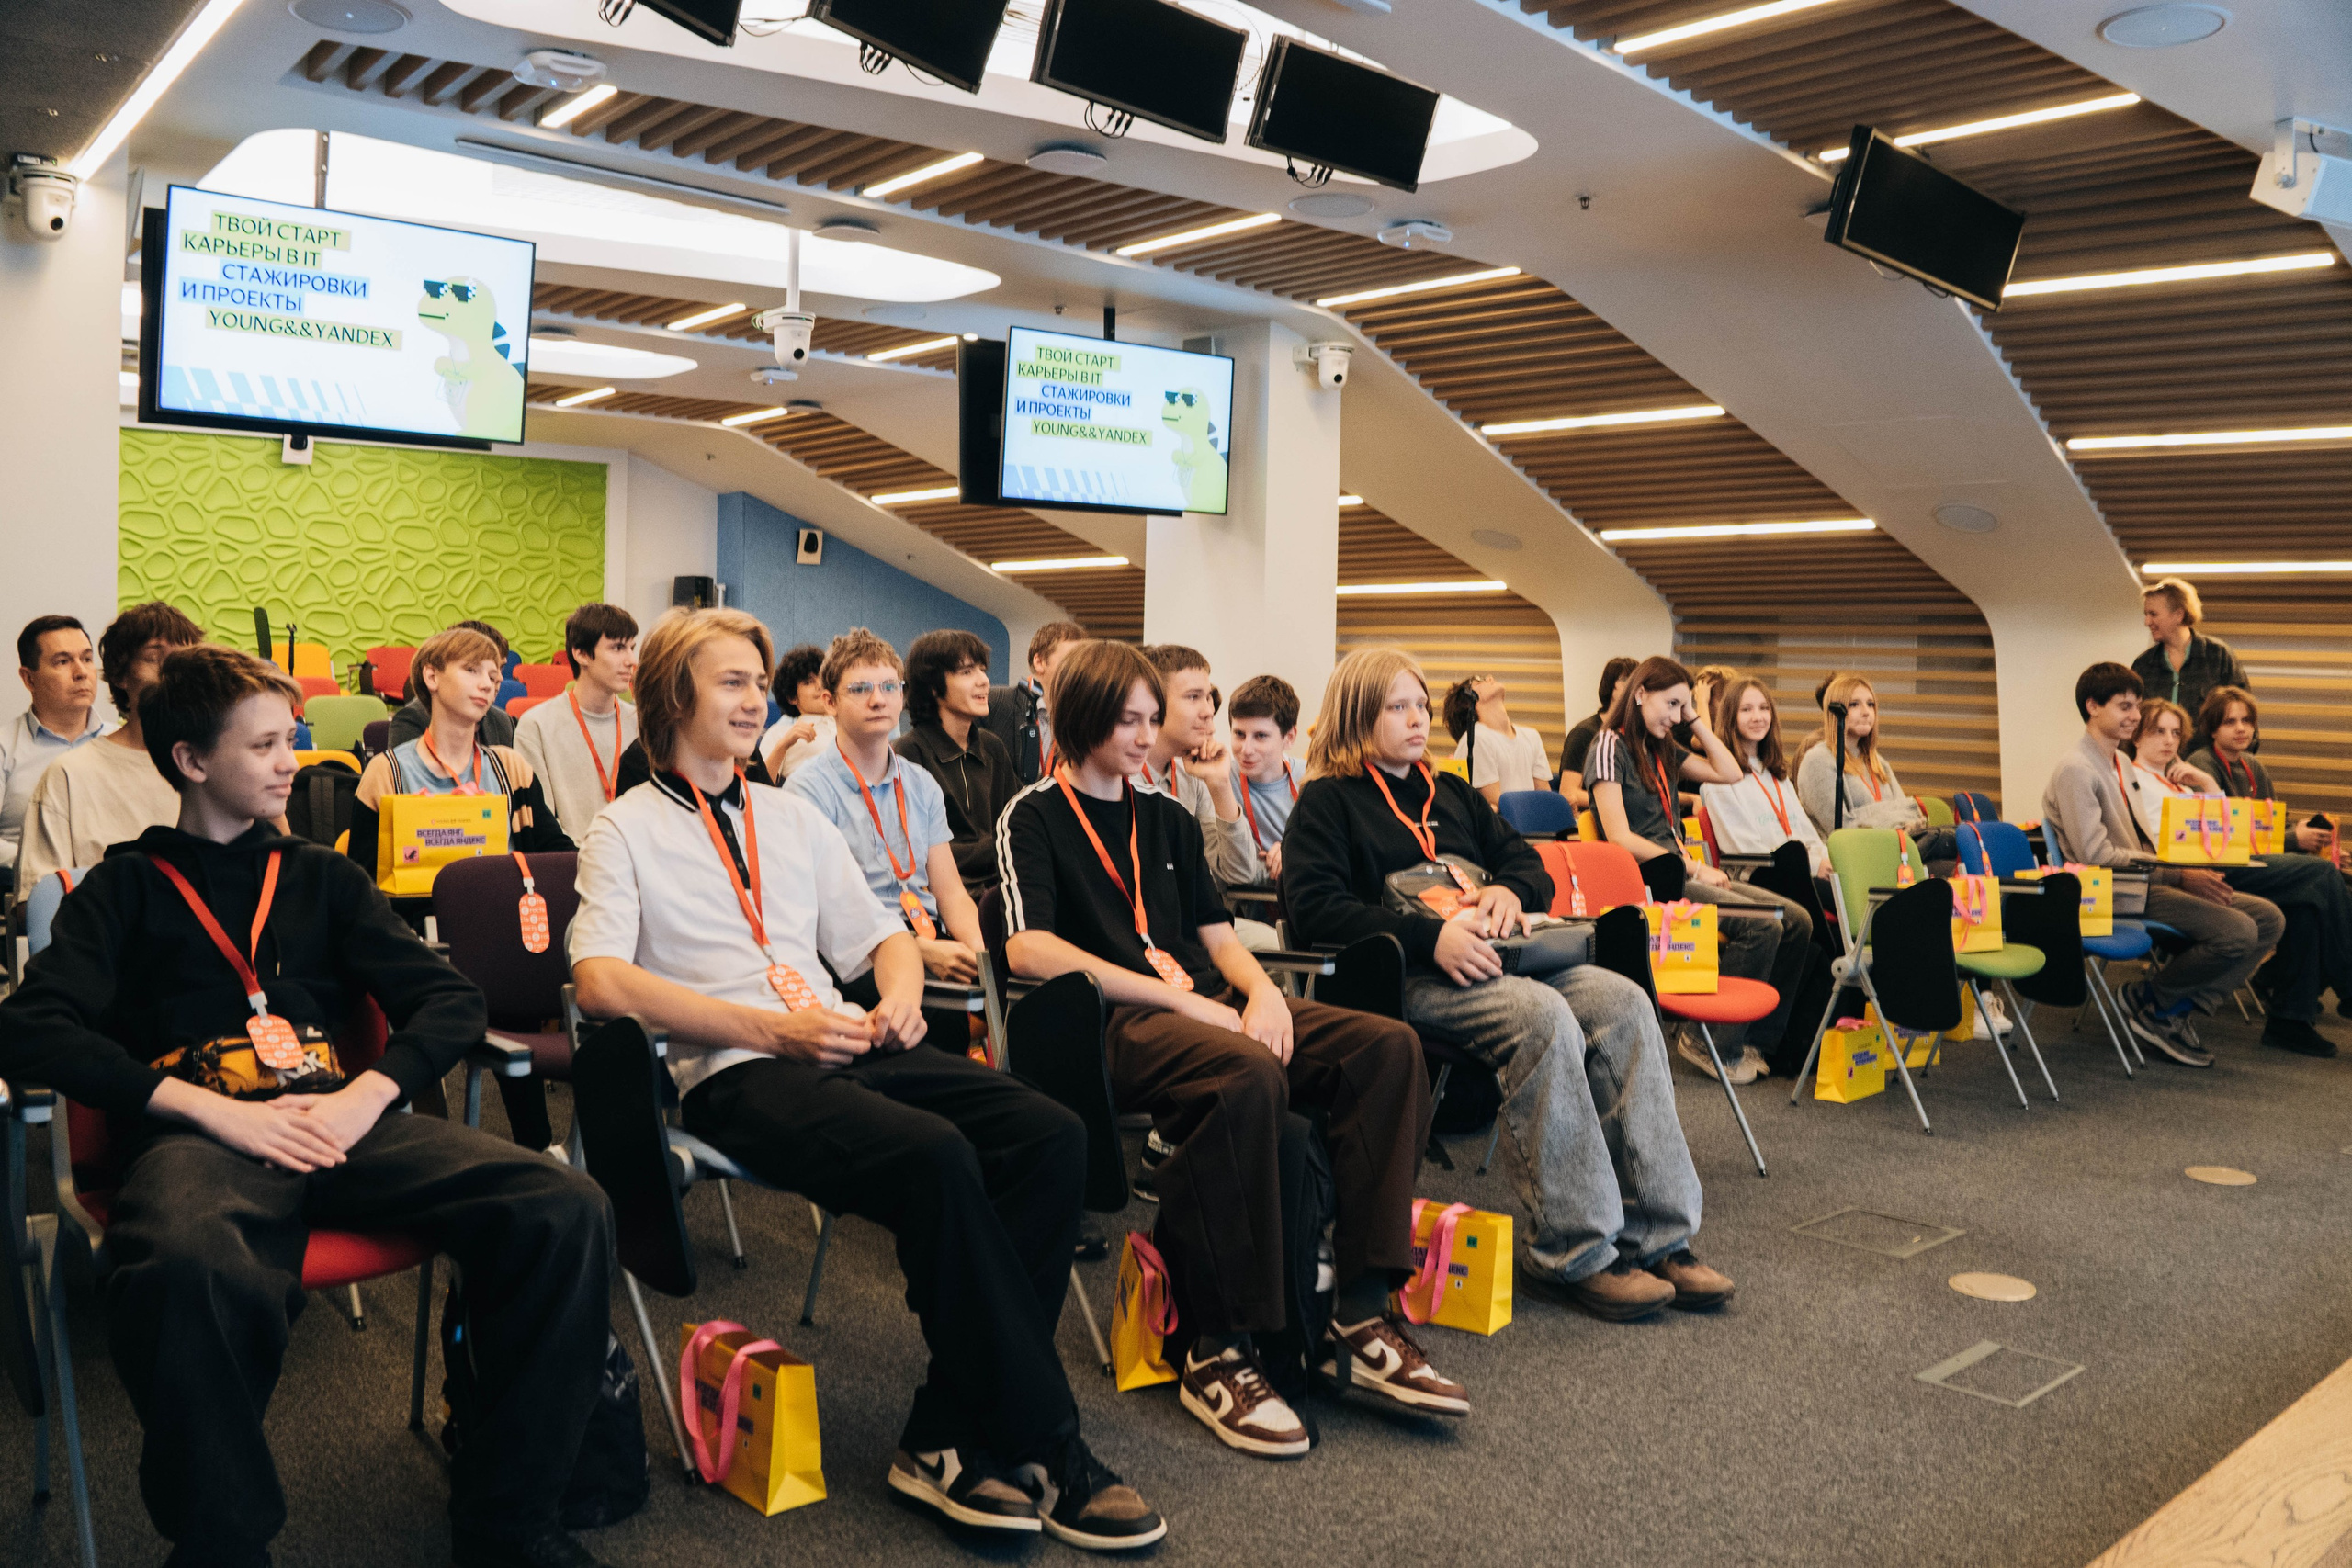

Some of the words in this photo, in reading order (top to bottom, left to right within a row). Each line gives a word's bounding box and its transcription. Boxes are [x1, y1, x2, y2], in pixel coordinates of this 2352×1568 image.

[214, 212, 273, 238] ТВОЙ
[277, 224, 341, 247] СТАРТ
[184, 233, 281, 262] КАРЬЕРЫ
[287, 248, 300, 264] В
[304, 251, 321, 267] IT
[222, 263, 367, 298] СТАЖИРОВКИ
[183, 282, 197, 299] И
[202, 284, 302, 312] ПРОЕКТЫ
[209, 310, 394, 347] YOUNG&&YANDEX
[1037, 347, 1072, 363] ТВОЙ
[1075, 353, 1114, 369] СТАРТ
[1017, 364, 1078, 382] КАРЬЕРЫ
[1080, 372, 1089, 383] В
[1091, 373, 1102, 385] IT
[1041, 385, 1131, 407] СТАЖИРОВКИ
[1016, 400, 1026, 413] И
[1029, 401, 1091, 420] ПРОЕКТЫ
[1033, 421, 1147, 444] YOUNG&&YANDEX
[417, 829, 447, 838] ВСЕГДА
[425, 837, 455, 846] ВСЕГДА
[457, 836, 486, 845] ЯНДЕКС
